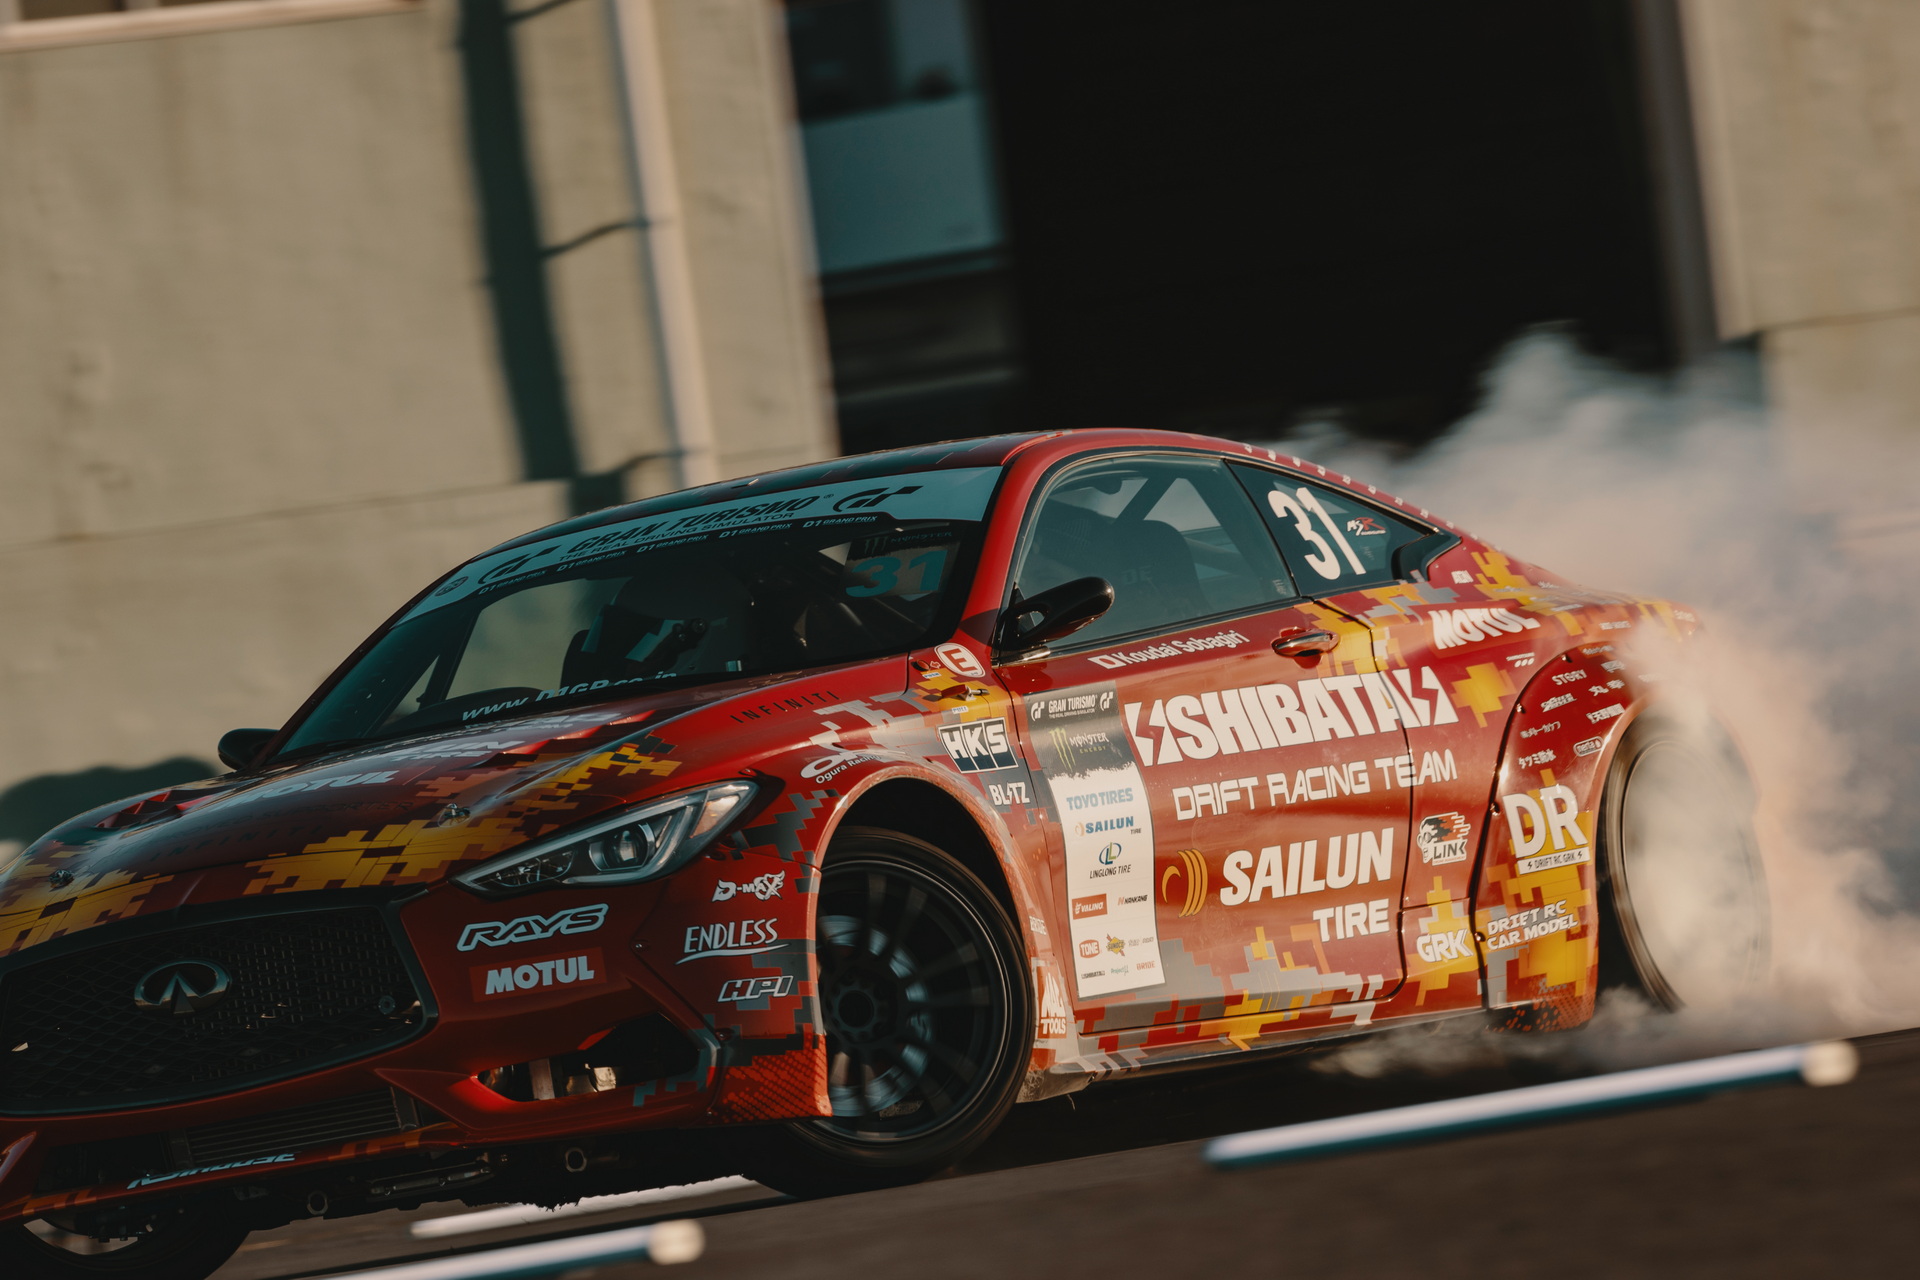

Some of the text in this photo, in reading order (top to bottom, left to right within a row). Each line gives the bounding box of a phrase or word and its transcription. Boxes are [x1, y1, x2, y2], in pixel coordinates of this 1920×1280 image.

[566, 495, 820, 554] GRAN TURISMO
[634, 527, 698, 544] DRIVING
[701, 512, 795, 531] SIMULATOR
[1267, 487, 1366, 580] 31
[845, 549, 949, 599] 31
[1427, 607, 1541, 650] MOTUL
[1112, 629, 1250, 665] Koudai Sobagiri
[730, 690, 841, 724] INFINITI
[1048, 698, 1066, 714] GRAN
[1067, 694, 1096, 711] TURISMO
[1165, 671, 1423, 760] SHIBATA
[942, 723, 1009, 760] HKS
[1069, 732, 1110, 748] MONSTER
[815, 763, 848, 784] Ogura
[1172, 748, 1458, 821] DRIFT RACING TEAM
[988, 781, 1031, 806] BLITZ
[1085, 815, 1134, 834] SAILUN
[1502, 784, 1589, 859] DR
[150, 825, 324, 862] INFINITI
[1434, 841, 1466, 860] LINK
[1089, 864, 1132, 879] LINGLONG TIRE
[1219, 827, 1394, 906] SAILUN
[1081, 902, 1104, 913] VALINO
[1312, 898, 1390, 943] TIRE
[1487, 899, 1567, 935] DRIFT RC
[456, 902, 610, 952] RAYS
[683, 917, 778, 954] ENDLESS
[1487, 913, 1579, 951] CAR MODEL
[1080, 941, 1099, 957] TONE
[1416, 928, 1474, 963] GRK
[485, 955, 595, 995] MOTUL
[717, 975, 794, 1002] HPI
[1040, 1017, 1067, 1035] TOOLS
